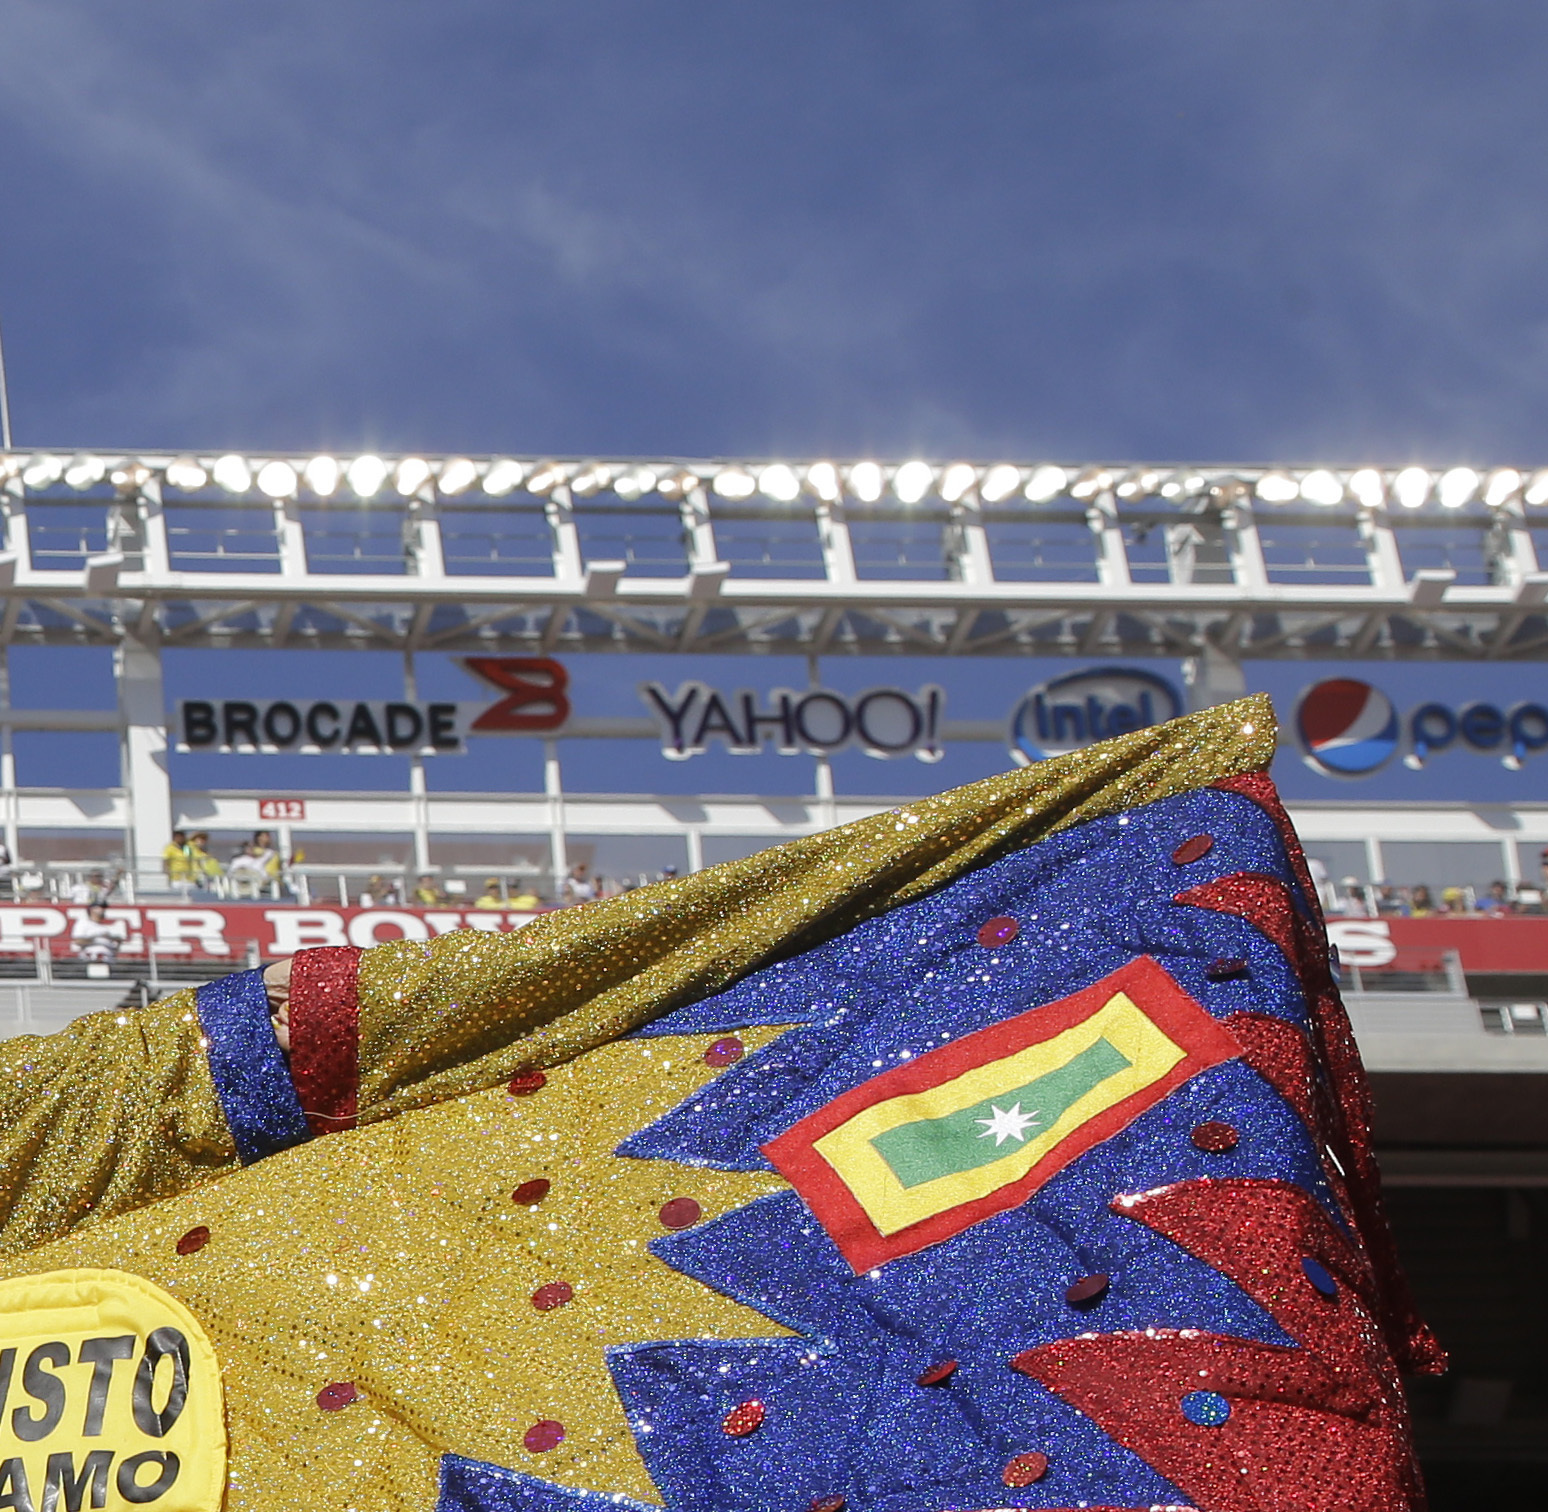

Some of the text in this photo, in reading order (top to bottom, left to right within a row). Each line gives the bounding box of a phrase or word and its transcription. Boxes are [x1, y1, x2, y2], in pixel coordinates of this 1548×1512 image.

[182, 701, 459, 749] BROCADE
[646, 689, 938, 757] YAHOO!
[1412, 702, 1548, 760] pep
[261, 800, 304, 818] 412
[264, 909, 540, 955] BOW
